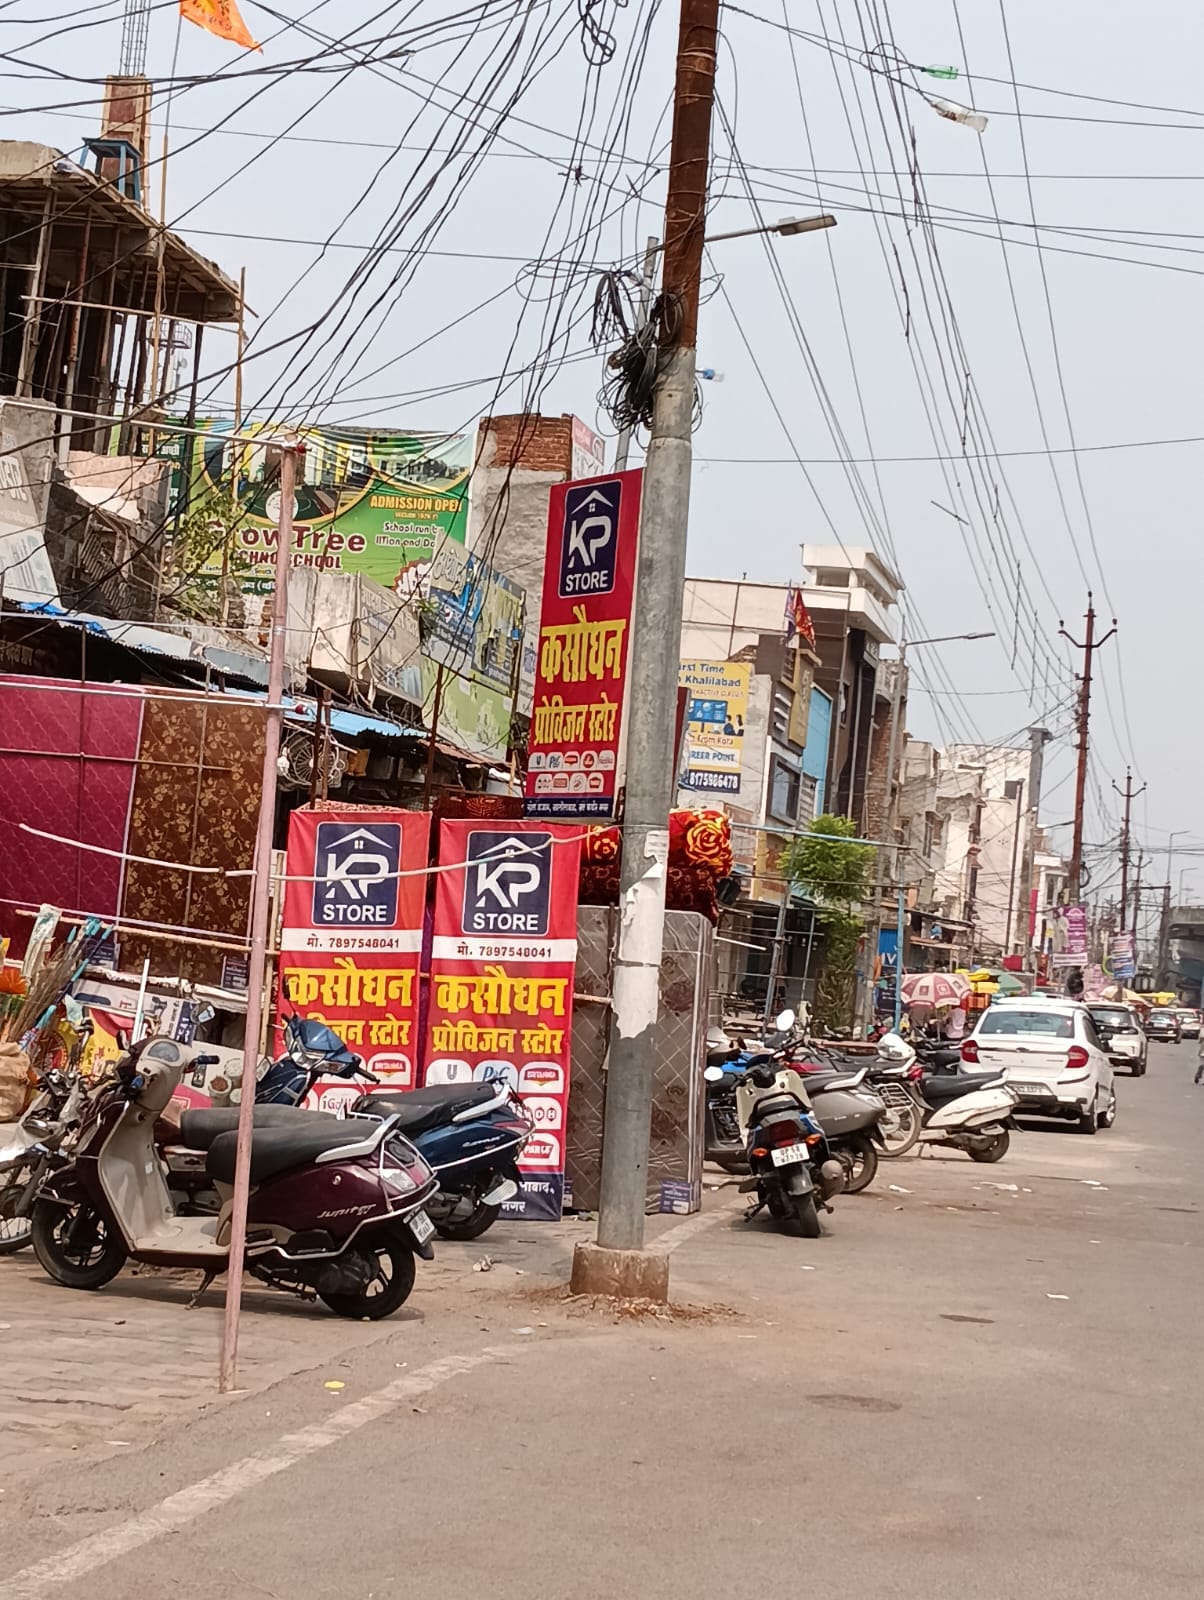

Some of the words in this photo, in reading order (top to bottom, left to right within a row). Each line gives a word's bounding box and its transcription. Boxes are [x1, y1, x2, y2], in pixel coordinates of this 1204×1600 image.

[369, 495, 433, 511] ADMISSION
[434, 499, 463, 513] OPEN
[384, 522, 413, 532] School
[568, 516, 612, 569] KP
[565, 570, 609, 592] STORE
[540, 604, 627, 683] कसौधन
[685, 675, 741, 687] Khalilabad
[700, 664, 725, 674] Time
[534, 694, 589, 746] प्रोविजन
[588, 691, 618, 742] स्टोर
[324, 853, 390, 899] KP
[475, 862, 541, 908] KP
[322, 904, 388, 922] STORE
[473, 912, 539, 931] STORE
[329, 938, 400, 949] 7897548041
[479, 946, 552, 957] 7897548041
[284, 957, 416, 1007] कसौधन
[434, 965, 569, 1015] कसौधन
[369, 1013, 412, 1045] स्टोर
[432, 1019, 519, 1053] प्रोविजन
[520, 1022, 564, 1054] स्टोर
